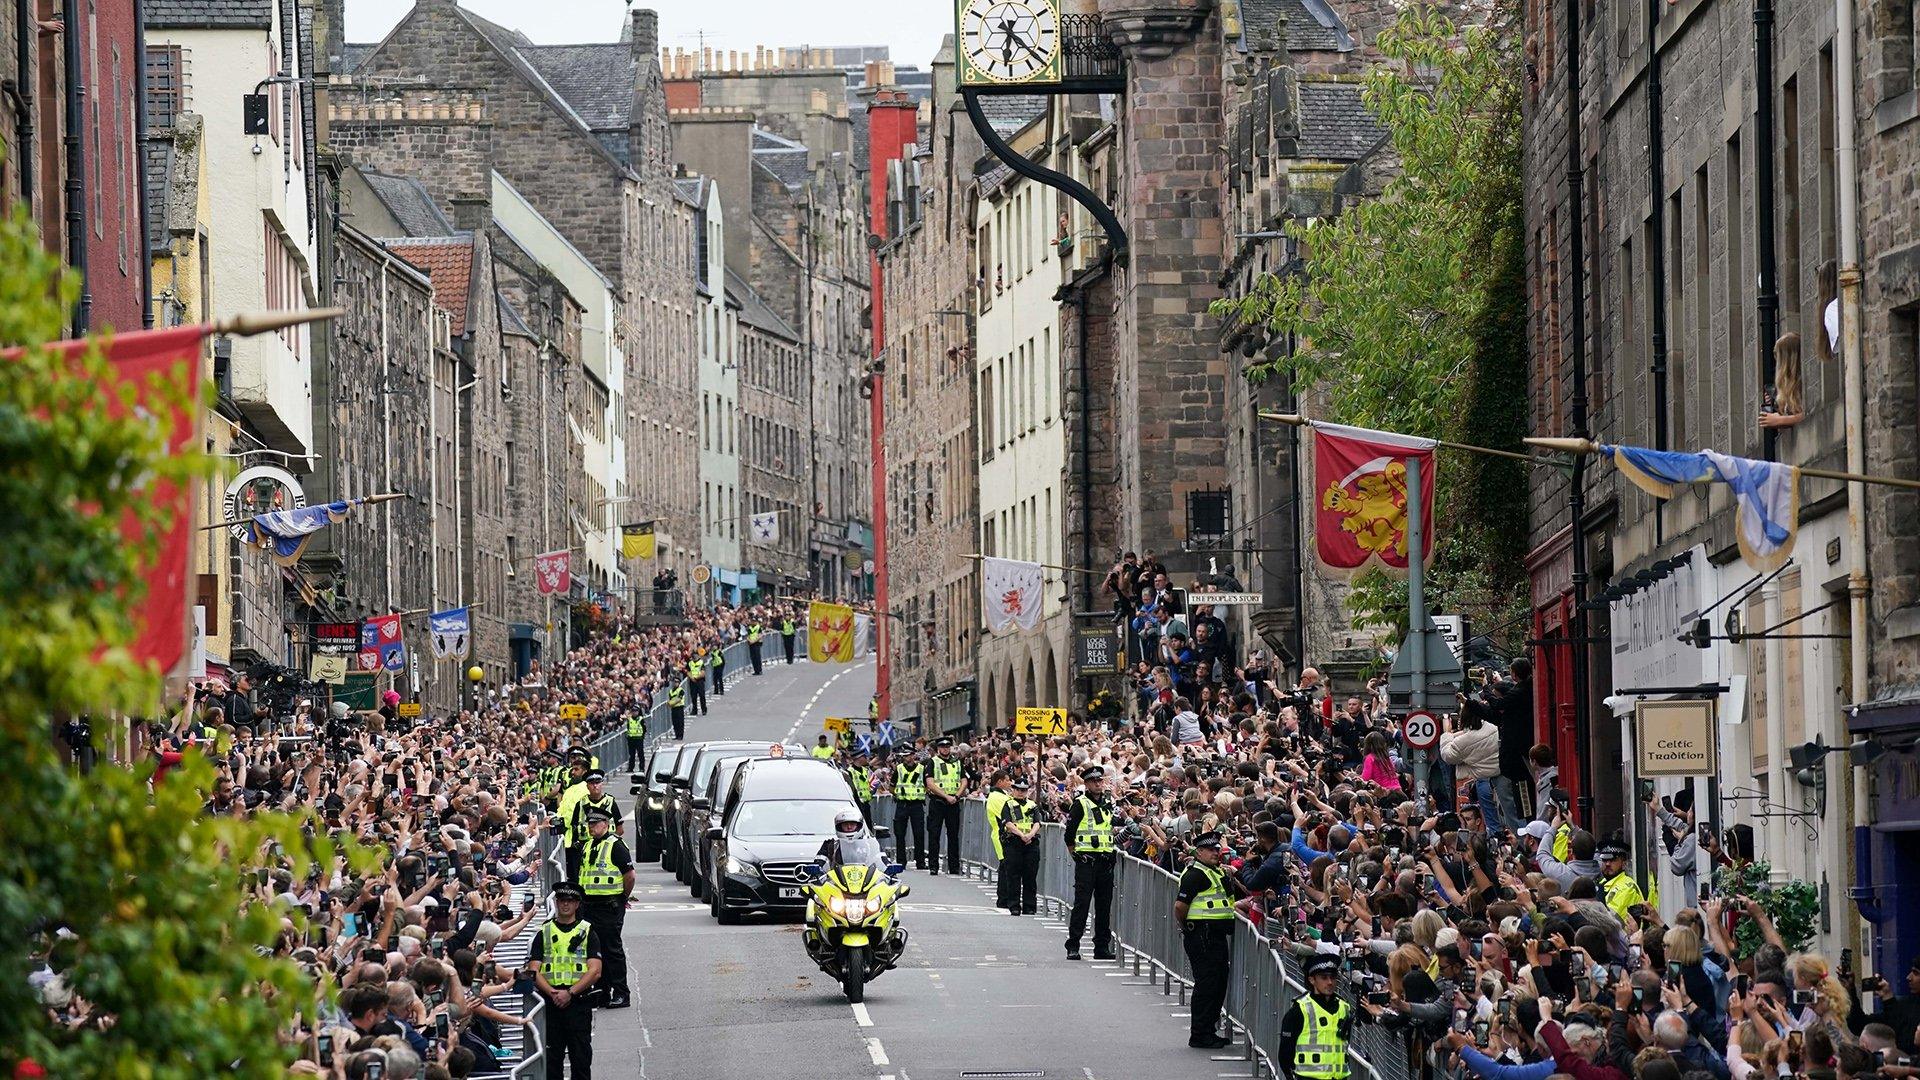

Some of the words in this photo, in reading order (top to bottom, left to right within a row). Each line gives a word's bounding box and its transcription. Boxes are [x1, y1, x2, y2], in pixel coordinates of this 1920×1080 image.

[965, 67, 976, 81] 8
[1045, 65, 1056, 79] 4
[1087, 656, 1107, 664] ALES
[1409, 722, 1434, 737] 20
[1657, 740, 1693, 748] Celtic
[1647, 751, 1704, 760] Tradition
